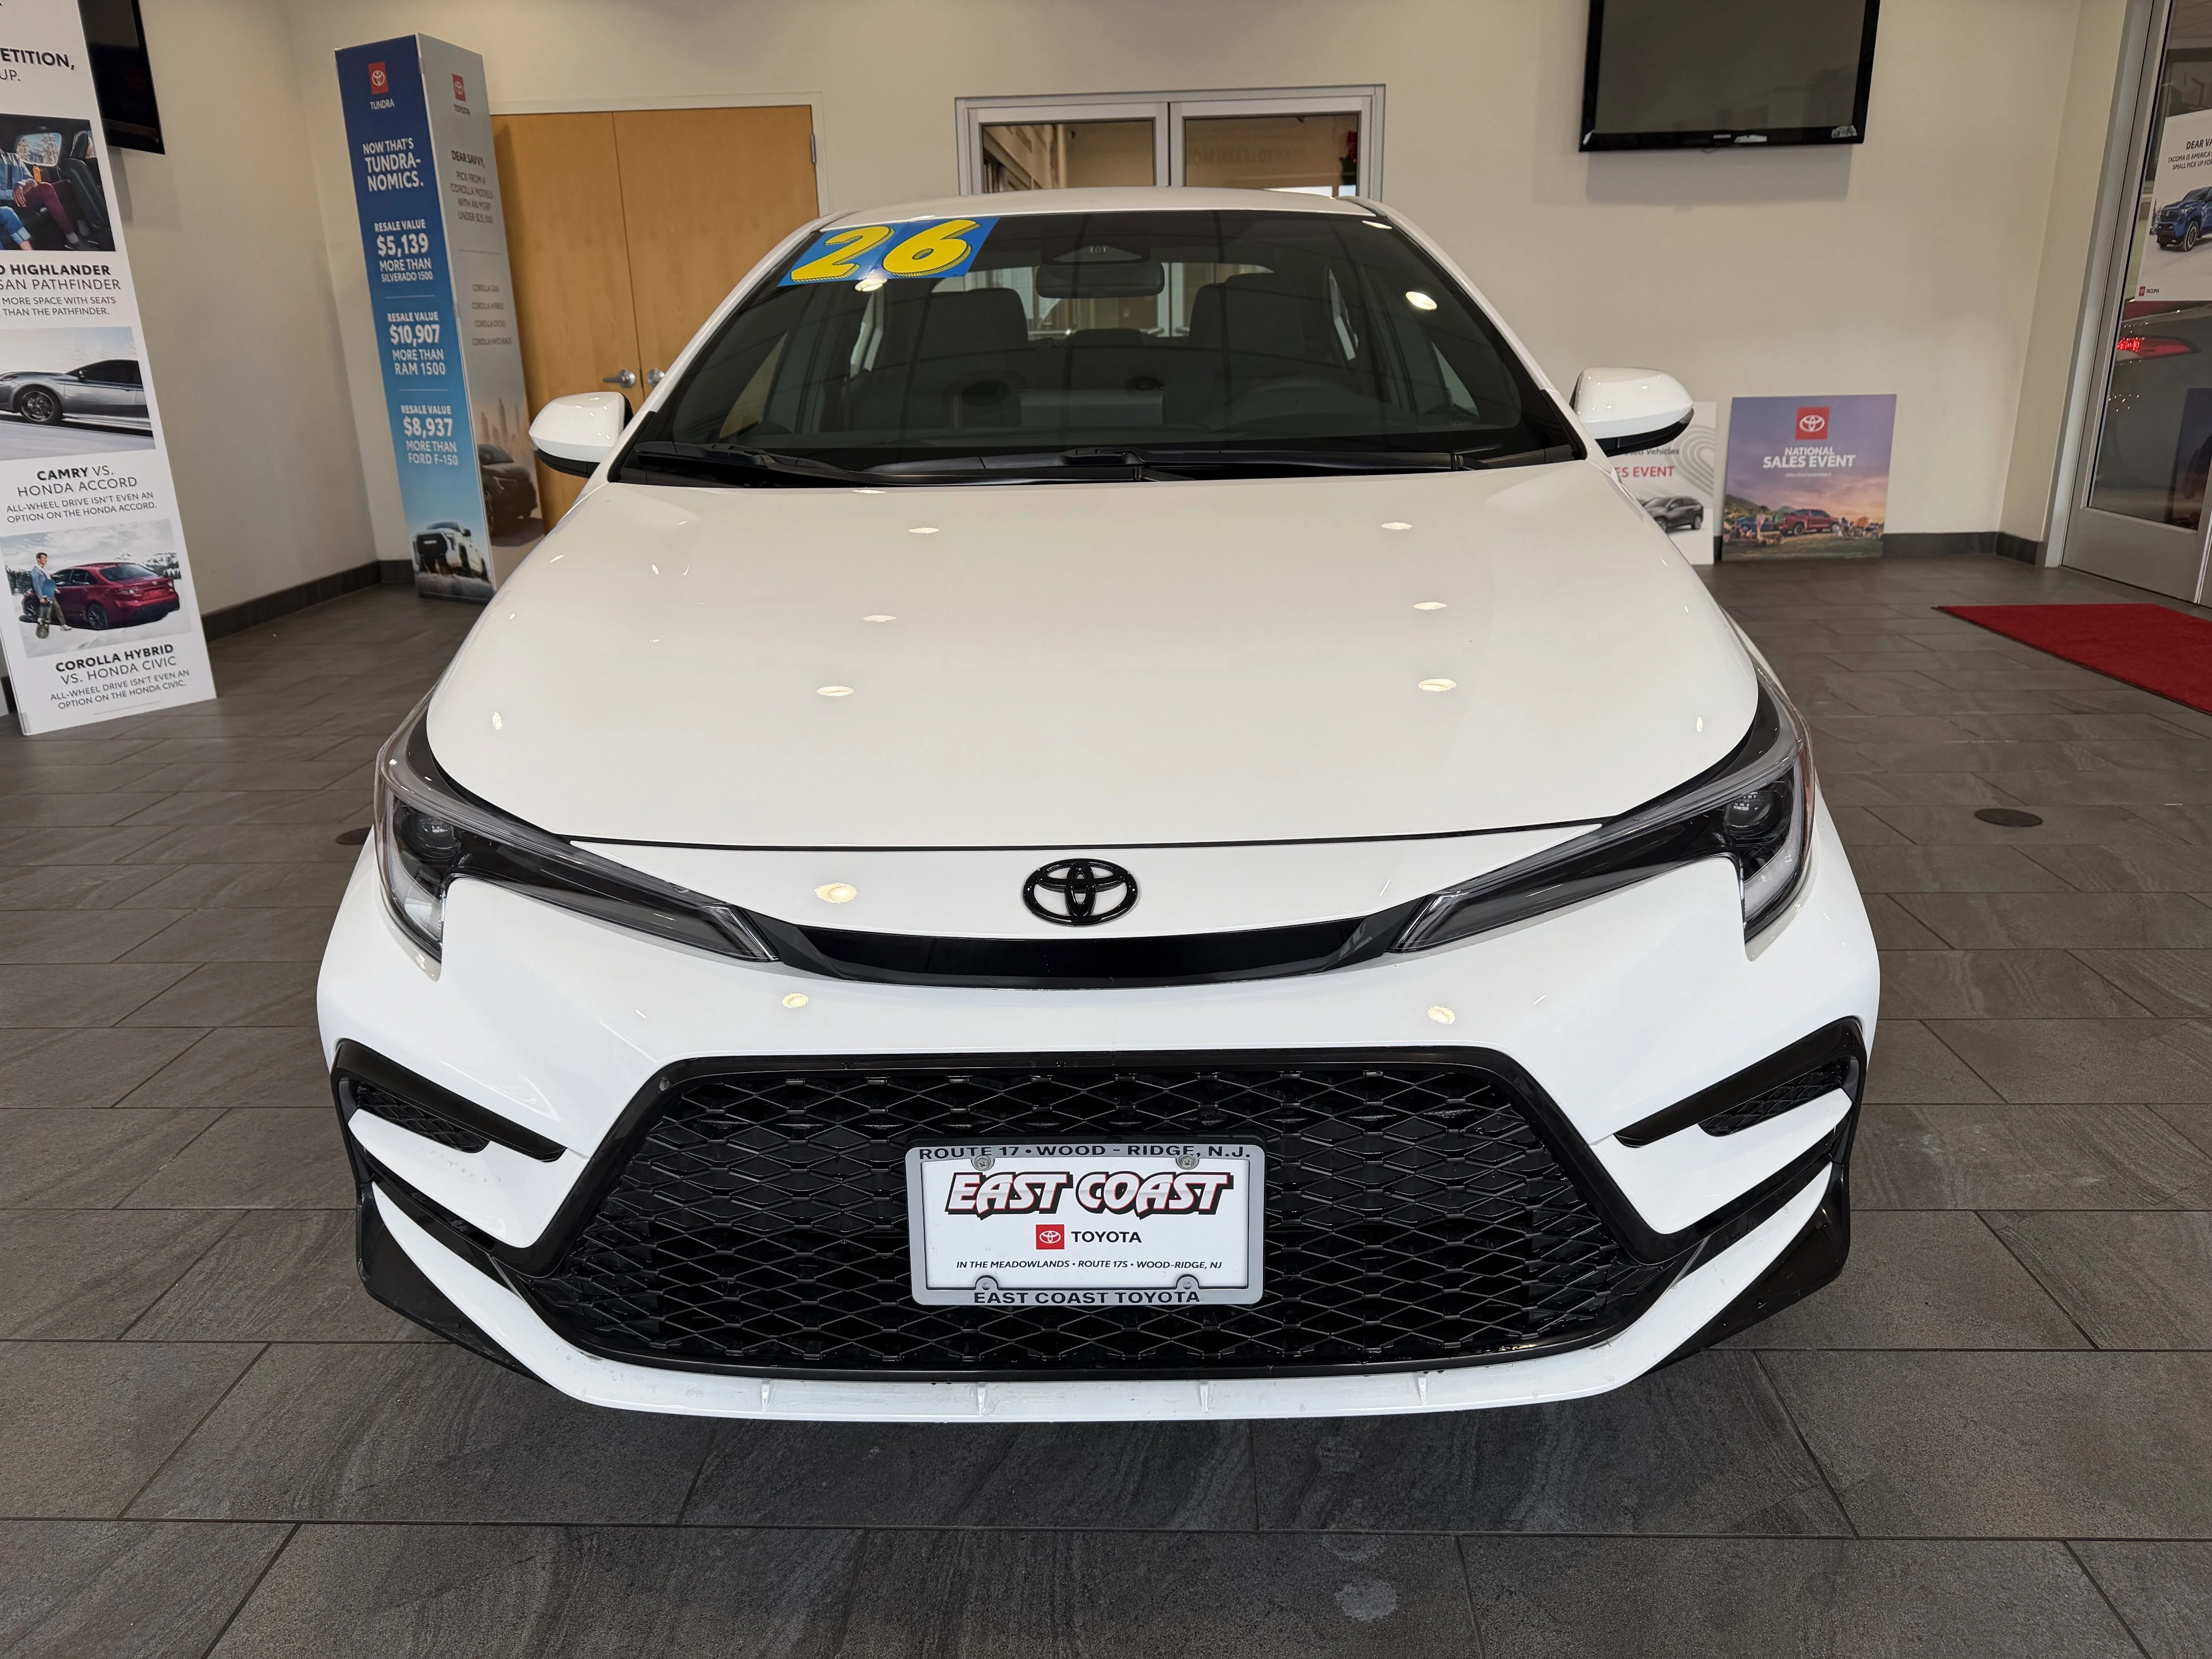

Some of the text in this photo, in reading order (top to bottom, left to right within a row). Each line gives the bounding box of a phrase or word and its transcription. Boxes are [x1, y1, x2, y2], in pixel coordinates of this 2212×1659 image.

[370, 98, 395, 110] TUNDRA
[362, 137, 414, 155] NOW THAT'S
[2186, 139, 2204, 149] DEAR
[365, 152, 421, 173] TUNDRA-
[451, 150, 467, 163] DEAR
[2168, 155, 2185, 163] TACOMA
[367, 170, 424, 192] NOMICS.
[450, 183, 474, 195] COROLLA
[374, 218, 426, 232] RESALE VALUE
[376, 233, 429, 258] $5,139
[791, 219, 980, 282] 26
[10, 264, 112, 275] HIGHLANDER
[379, 257, 432, 272] MORE THAN
[381, 270, 434, 282] SILVERADO 1500
[32, 279, 121, 290] PATHFINDER
[52, 307, 110, 315] PATHFINDER.
[387, 311, 440, 322] RESALE VALUE
[389, 324, 440, 347] $10,907
[392, 349, 445, 361] MORE THAN
[394, 362, 446, 376] RAM 1500
[400, 405, 452, 415] RESALE VALUE
[403, 416, 453, 439] $8,937
[406, 440, 457, 453] MORE THAN
[1784, 446, 1835, 456] NATIONAL
[408, 453, 459, 465] FORD F-150
[1763, 454, 1856, 469] SALES EVENT
[37, 465, 114, 481] CAMRY VS.
[1633, 465, 1675, 477] EVENT
[17, 477, 137, 497] HONDA ACCORD
[6, 491, 154, 513] ALL-WHEEL DRIVE ISN'T EVEN AN
[7, 513, 44, 523] OPTION
[63, 509, 81, 517] THE
[83, 505, 117, 515] HONDA
[118, 501, 157, 512] ACCORD.
[55, 644, 174, 672] COROLLA HYBRID
[60, 656, 177, 685] VS. HONDA CIVIC
[50, 669, 190, 701] ALL-WHEEL DRIVE ISN'T EVEN AN
[58, 679, 187, 709] OPTION ON THE HONDA CIVIC.
[919, 1147, 993, 1159] ROUTE
[999, 1147, 1019, 1156] 17
[1036, 1146, 1106, 1156] WOOD
[1127, 1146, 1200, 1158] RIDGE,
[1208, 1146, 1250, 1158] N.J.
[945, 1171, 1234, 1220] EAST COAST
[1071, 1231, 1142, 1243] TOYOTA
[990, 1260, 1070, 1268] MEADOWLANDS
[1137, 1261, 1207, 1269] WOOD-RIDGE,
[974, 1291, 1200, 1304] EAST COAST TOYOTA
